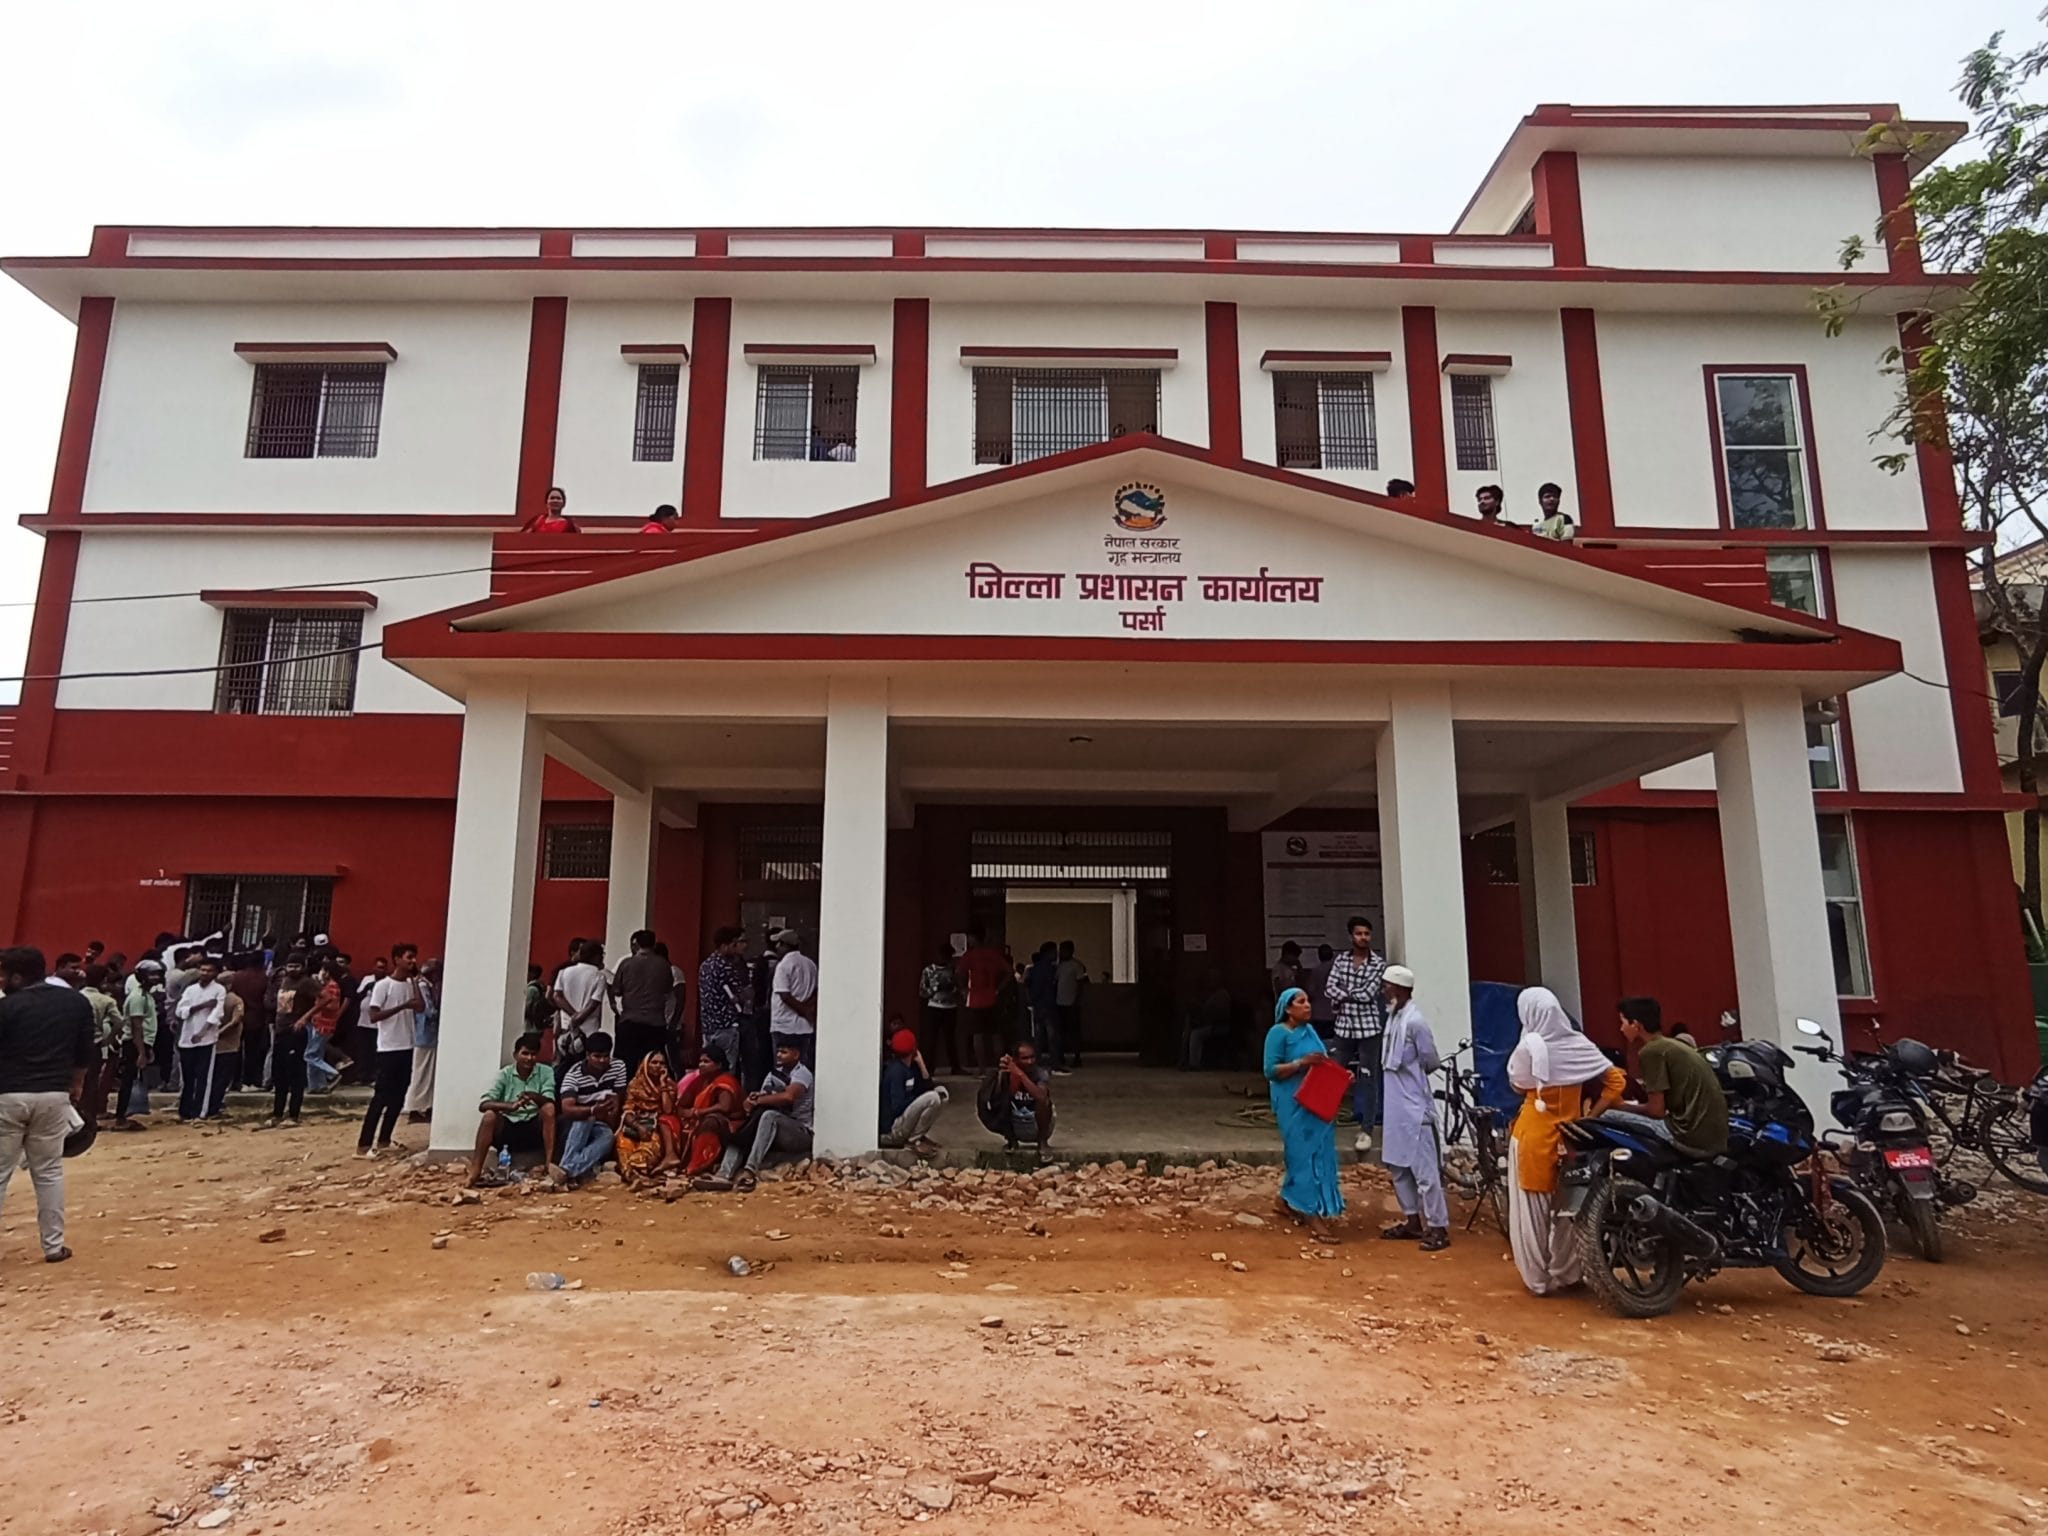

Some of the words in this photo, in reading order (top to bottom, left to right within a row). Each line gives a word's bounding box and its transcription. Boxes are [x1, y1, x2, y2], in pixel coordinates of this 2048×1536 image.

[1104, 535, 1137, 548] नेपाल
[1139, 537, 1181, 550] सरकार
[1107, 551, 1129, 566] गृह
[1131, 551, 1182, 565] मन्त्रालय
[965, 562, 1065, 600] जिल्ला
[1075, 571, 1187, 602] प्रशासन
[1198, 566, 1324, 603] कार्यालय
[1118, 605, 1167, 632] पर्सा
